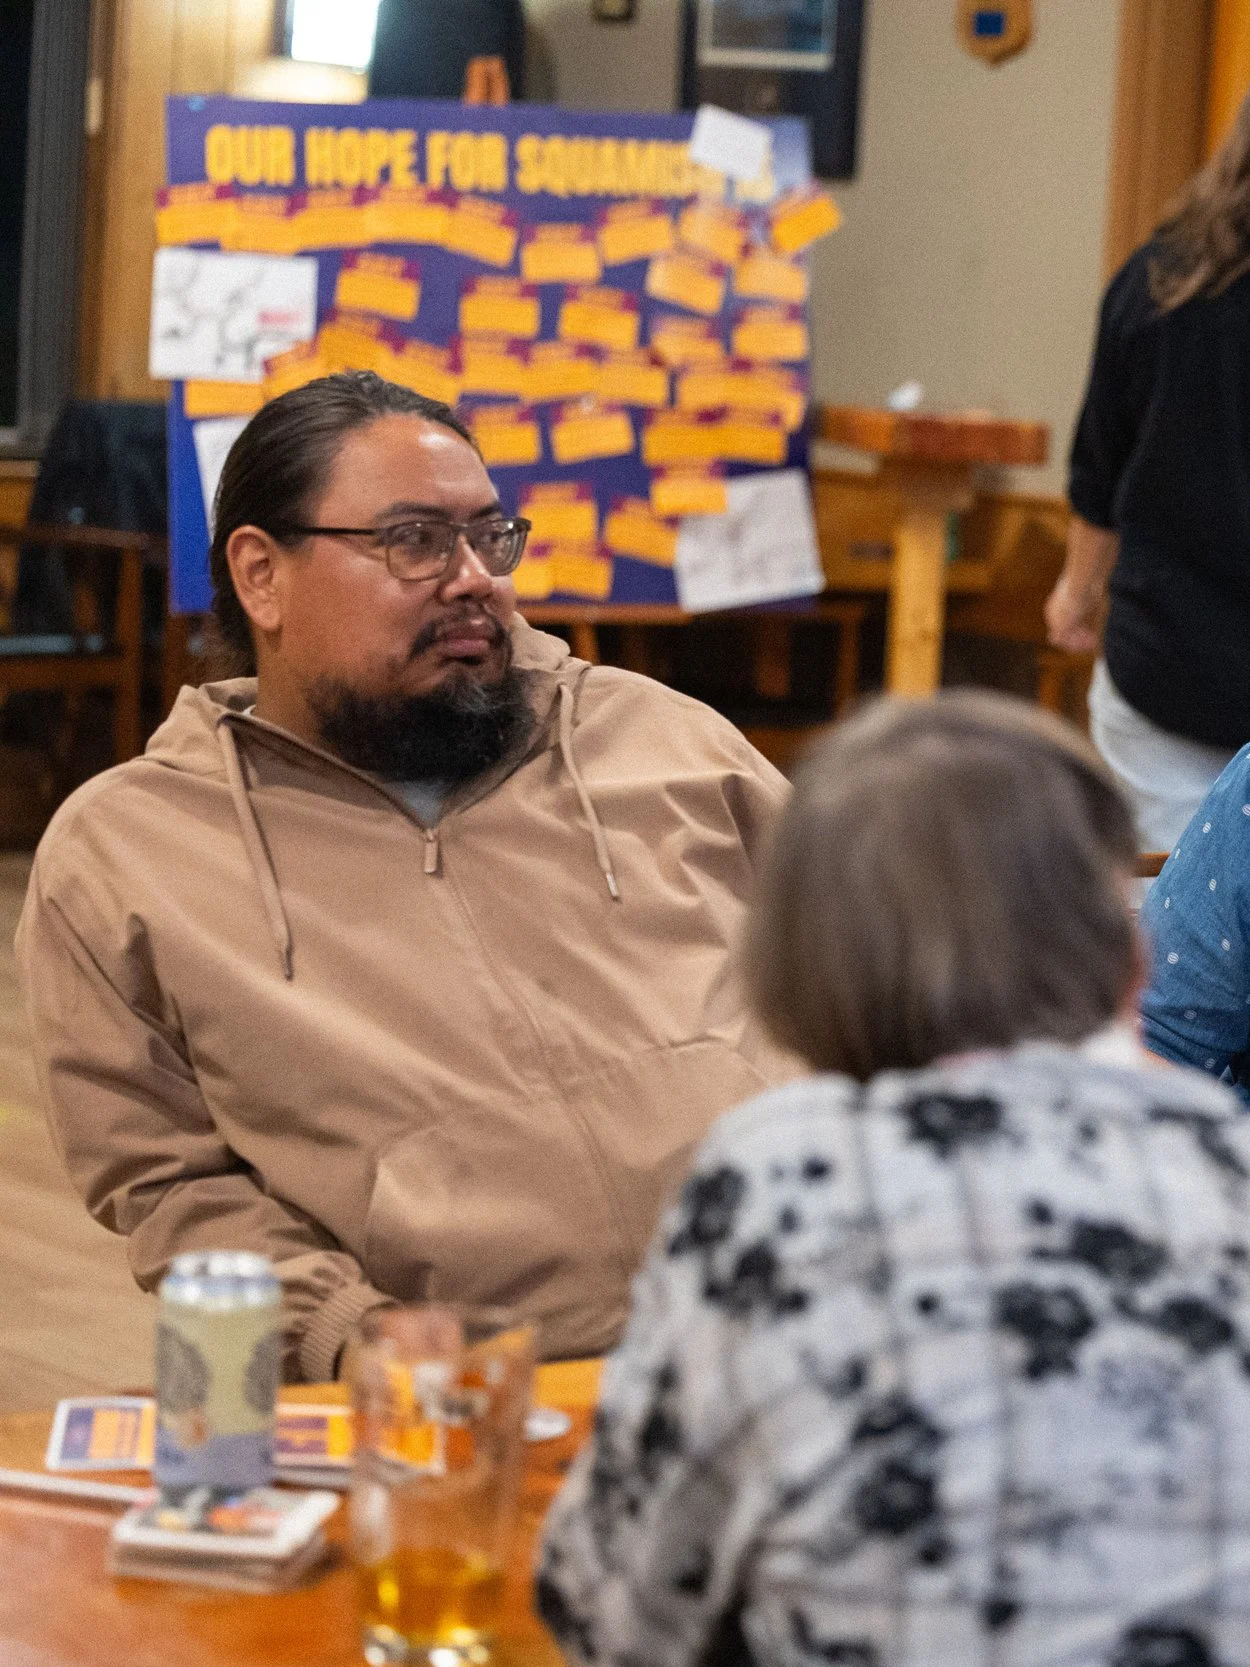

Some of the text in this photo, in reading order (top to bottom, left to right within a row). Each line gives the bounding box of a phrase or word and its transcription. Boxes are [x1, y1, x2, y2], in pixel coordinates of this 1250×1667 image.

[205, 124, 295, 185] OUR
[304, 127, 418, 190] HOPE
[425, 131, 508, 192] FOR
